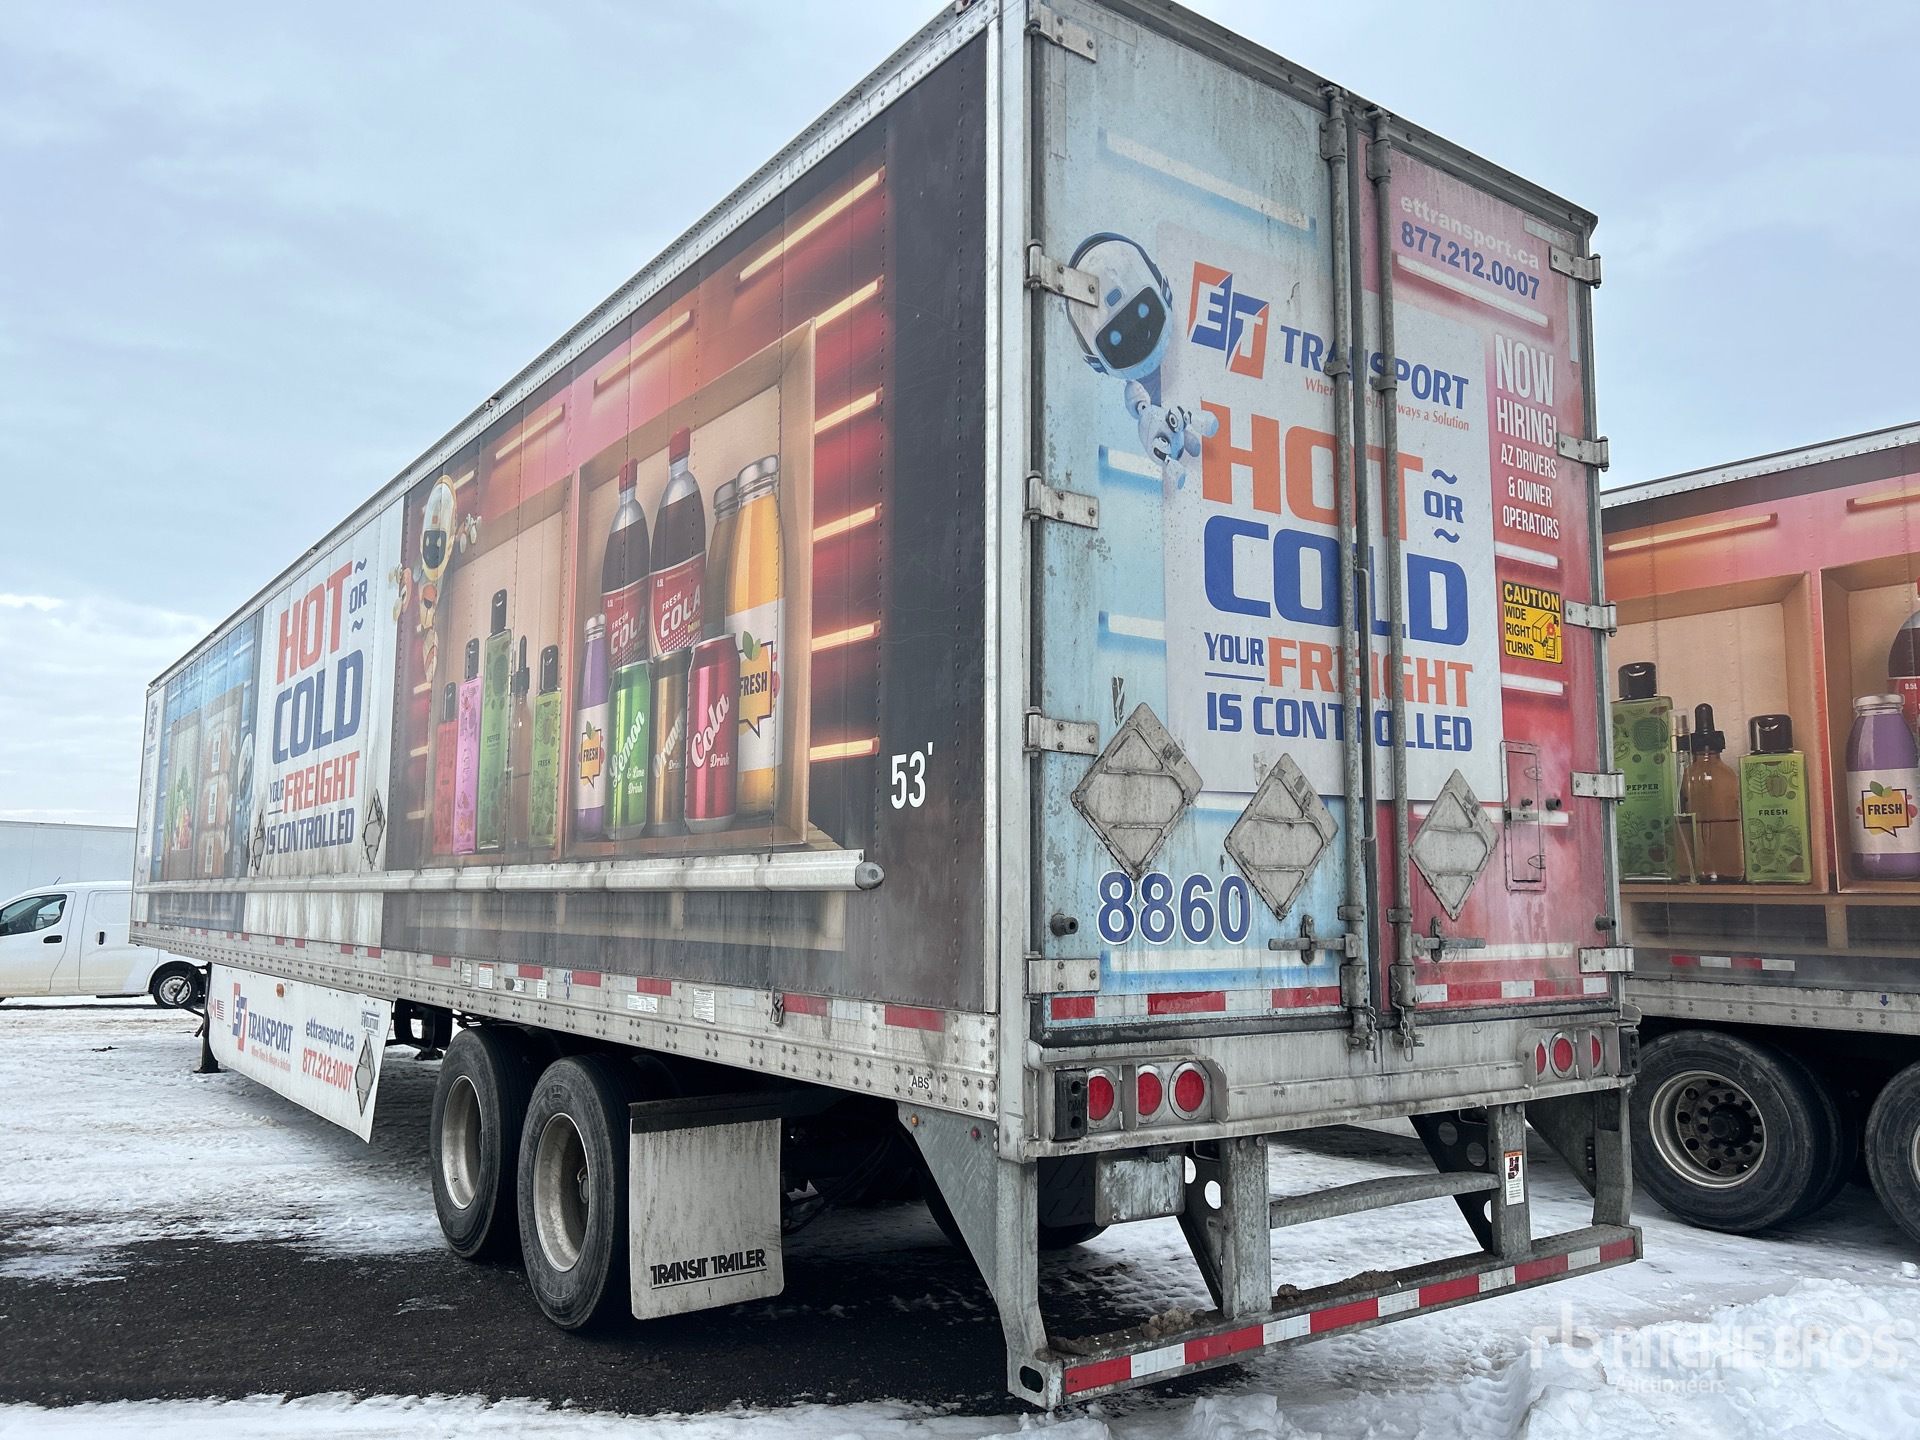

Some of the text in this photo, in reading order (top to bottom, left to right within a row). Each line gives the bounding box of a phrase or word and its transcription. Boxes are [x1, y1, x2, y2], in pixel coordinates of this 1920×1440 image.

[1400, 196, 1539, 270] ettransport.ca
[1401, 221, 1540, 300] 877.212.0007
[1495, 334, 1554, 407] NOW
[1305, 377, 1337, 397] Wher
[1397, 403, 1421, 421] ways
[1423, 411, 1429, 420] a
[1432, 411, 1469, 431] Solution
[1496, 397, 1557, 450] HIRING!
[1201, 400, 1423, 541] HOT
[1501, 443, 1557, 480] AZ DRIVERS
[1423, 490, 1464, 523] OR
[1508, 476, 1552, 508] & OWNER
[1503, 505, 1559, 539] OPERATORS
[349, 579, 367, 614] OR
[1204, 515, 1469, 646] COLD
[1504, 583, 1560, 611] CAUTION
[276, 560, 353, 686] HOT
[610, 605, 645, 655] COLA
[661, 584, 700, 638] COLA
[1505, 605, 1526, 621] WIDE
[1505, 622, 1531, 638] RIGHT
[1204, 632, 1473, 708] YOUR FREIGHT
[1506, 640, 1535, 656] TURNS
[272, 649, 363, 765] COLD
[740, 671, 768, 698] FRESH
[691, 693, 730, 769] Cola
[1207, 692, 1472, 752] IS CONTOLED
[583, 747, 598, 762] FRESH
[609, 710, 646, 788] Lemon
[709, 753, 730, 769] Drink
[269, 779, 285, 804] YOUR
[283, 750, 360, 815] FREIGHT
[891, 741, 934, 810] 53'
[1626, 783, 1659, 791] PEPPER
[266, 807, 355, 856] IS CONTROLLED
[1867, 803, 1902, 815] FRESH
[1097, 869, 1252, 945] 8860
[248, 1011, 293, 1054] TRANSPORT
[305, 1016, 354, 1052] ettransport.ca
[302, 1047, 354, 1093] 877.212.0007
[911, 1075, 930, 1090] ABS
[650, 1248, 767, 1285] TRANSIT TRAILER
